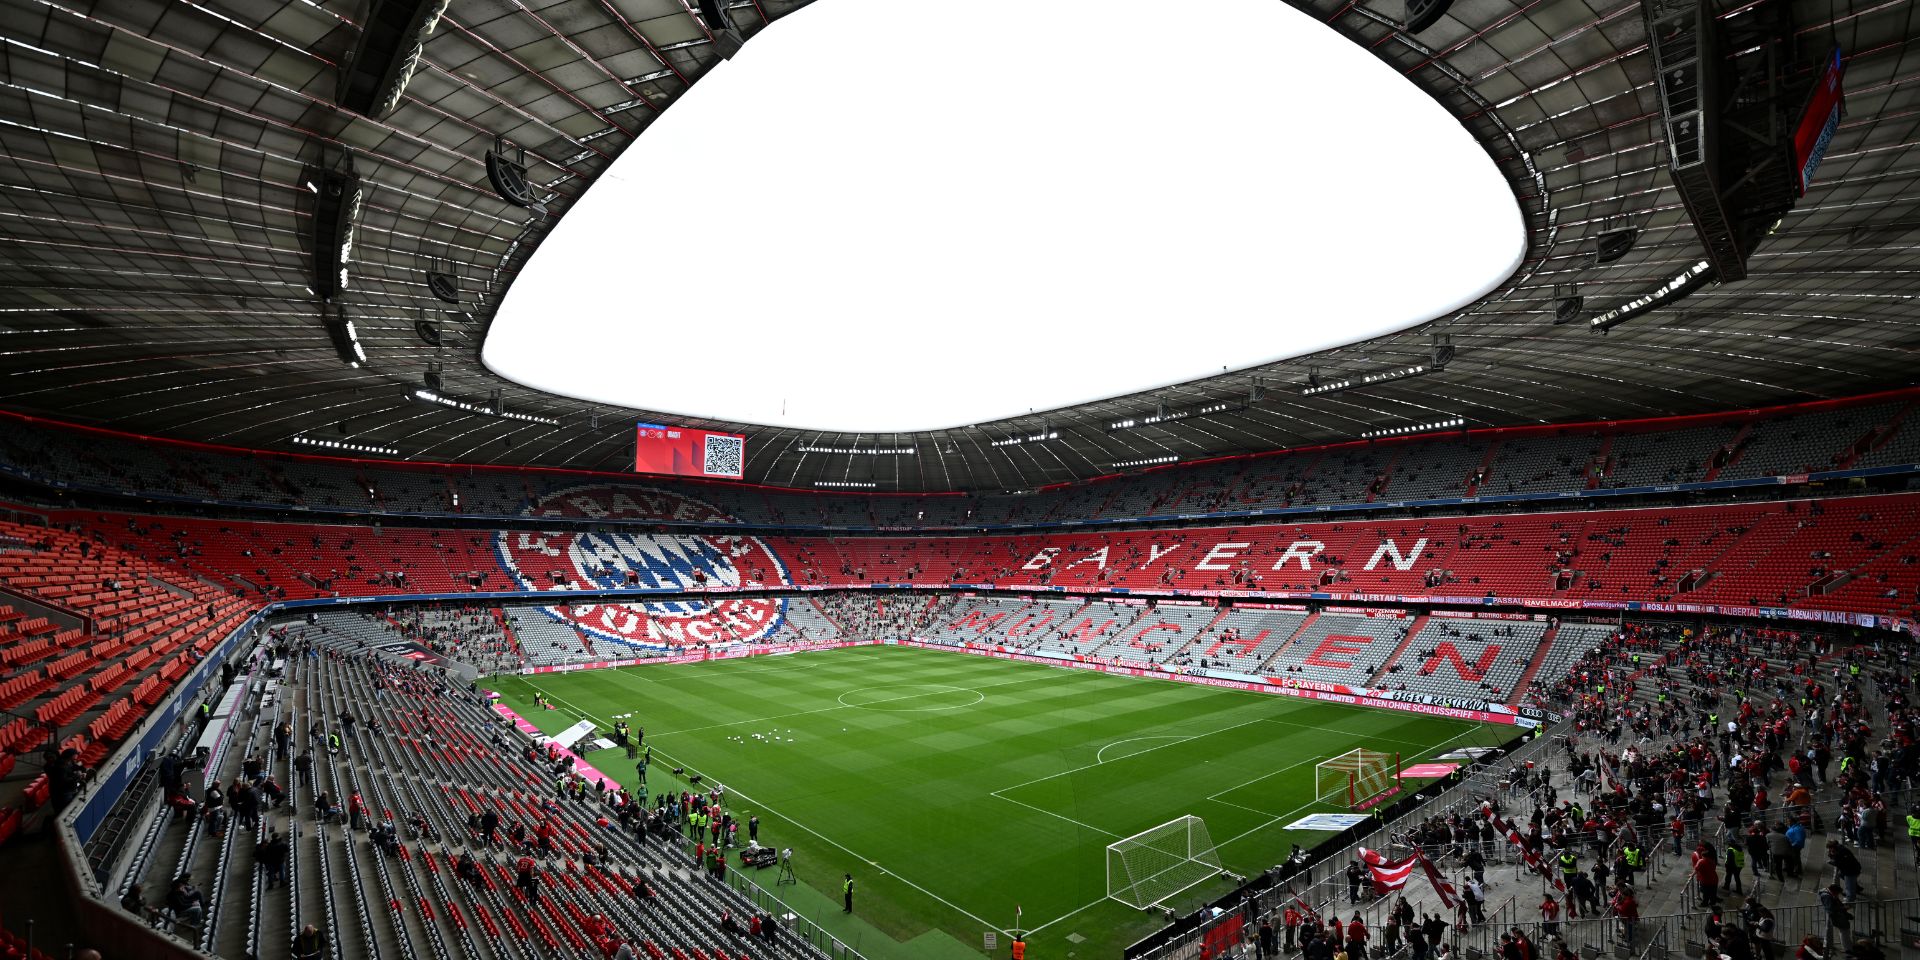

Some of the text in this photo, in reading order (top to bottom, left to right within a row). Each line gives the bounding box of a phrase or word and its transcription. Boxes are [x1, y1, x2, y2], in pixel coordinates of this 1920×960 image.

[1021, 537, 1428, 571] BAYERN
[1349, 593, 1397, 602] HALLERTAU
[1492, 597, 1524, 605] PASSAU
[1524, 600, 1580, 608] HAVELMACHT
[1646, 603, 1675, 611] ROSLAU
[1718, 606, 1759, 617] TAUBERTAL
[949, 608, 1502, 682] MÜNCHEN
[1106, 666, 1131, 675] UNLIMITED
[1143, 671, 1171, 679] UNLIMITED
[1263, 685, 1300, 696] UNLIMITED
[1282, 680, 1334, 692] FC BAYERN
[1316, 693, 1356, 704] UNLIMITED
[1392, 692, 1425, 704] GEGEN
[1362, 698, 1474, 719] DATEN OHNE SCHLUSSPFIFF
[1515, 716, 1536, 727] Allianz
